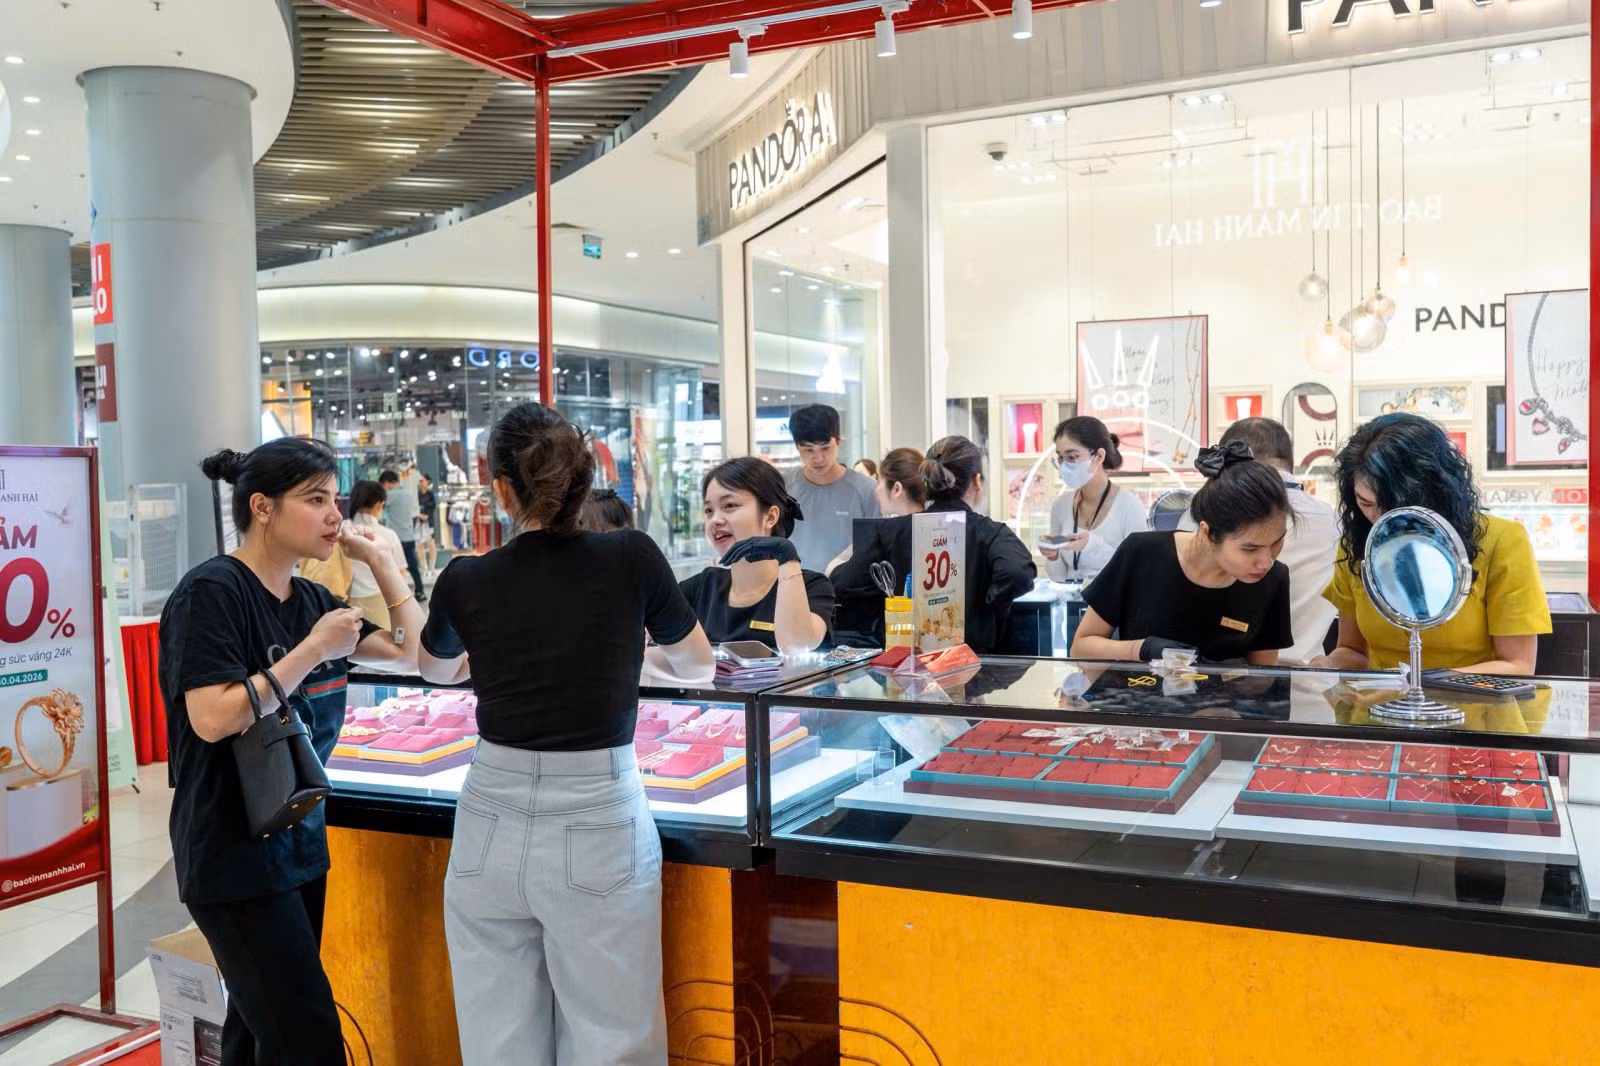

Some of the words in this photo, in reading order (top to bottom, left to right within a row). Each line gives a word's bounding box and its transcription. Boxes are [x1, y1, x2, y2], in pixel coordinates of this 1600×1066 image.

[729, 92, 836, 210] PANDORA
[1415, 303, 1506, 332] PAND
[923, 551, 958, 591] 30%
[28, 650, 53, 663] vàng
[54, 646, 73, 659] 24K
[13, 862, 86, 888] baotinmanhhai.vn
